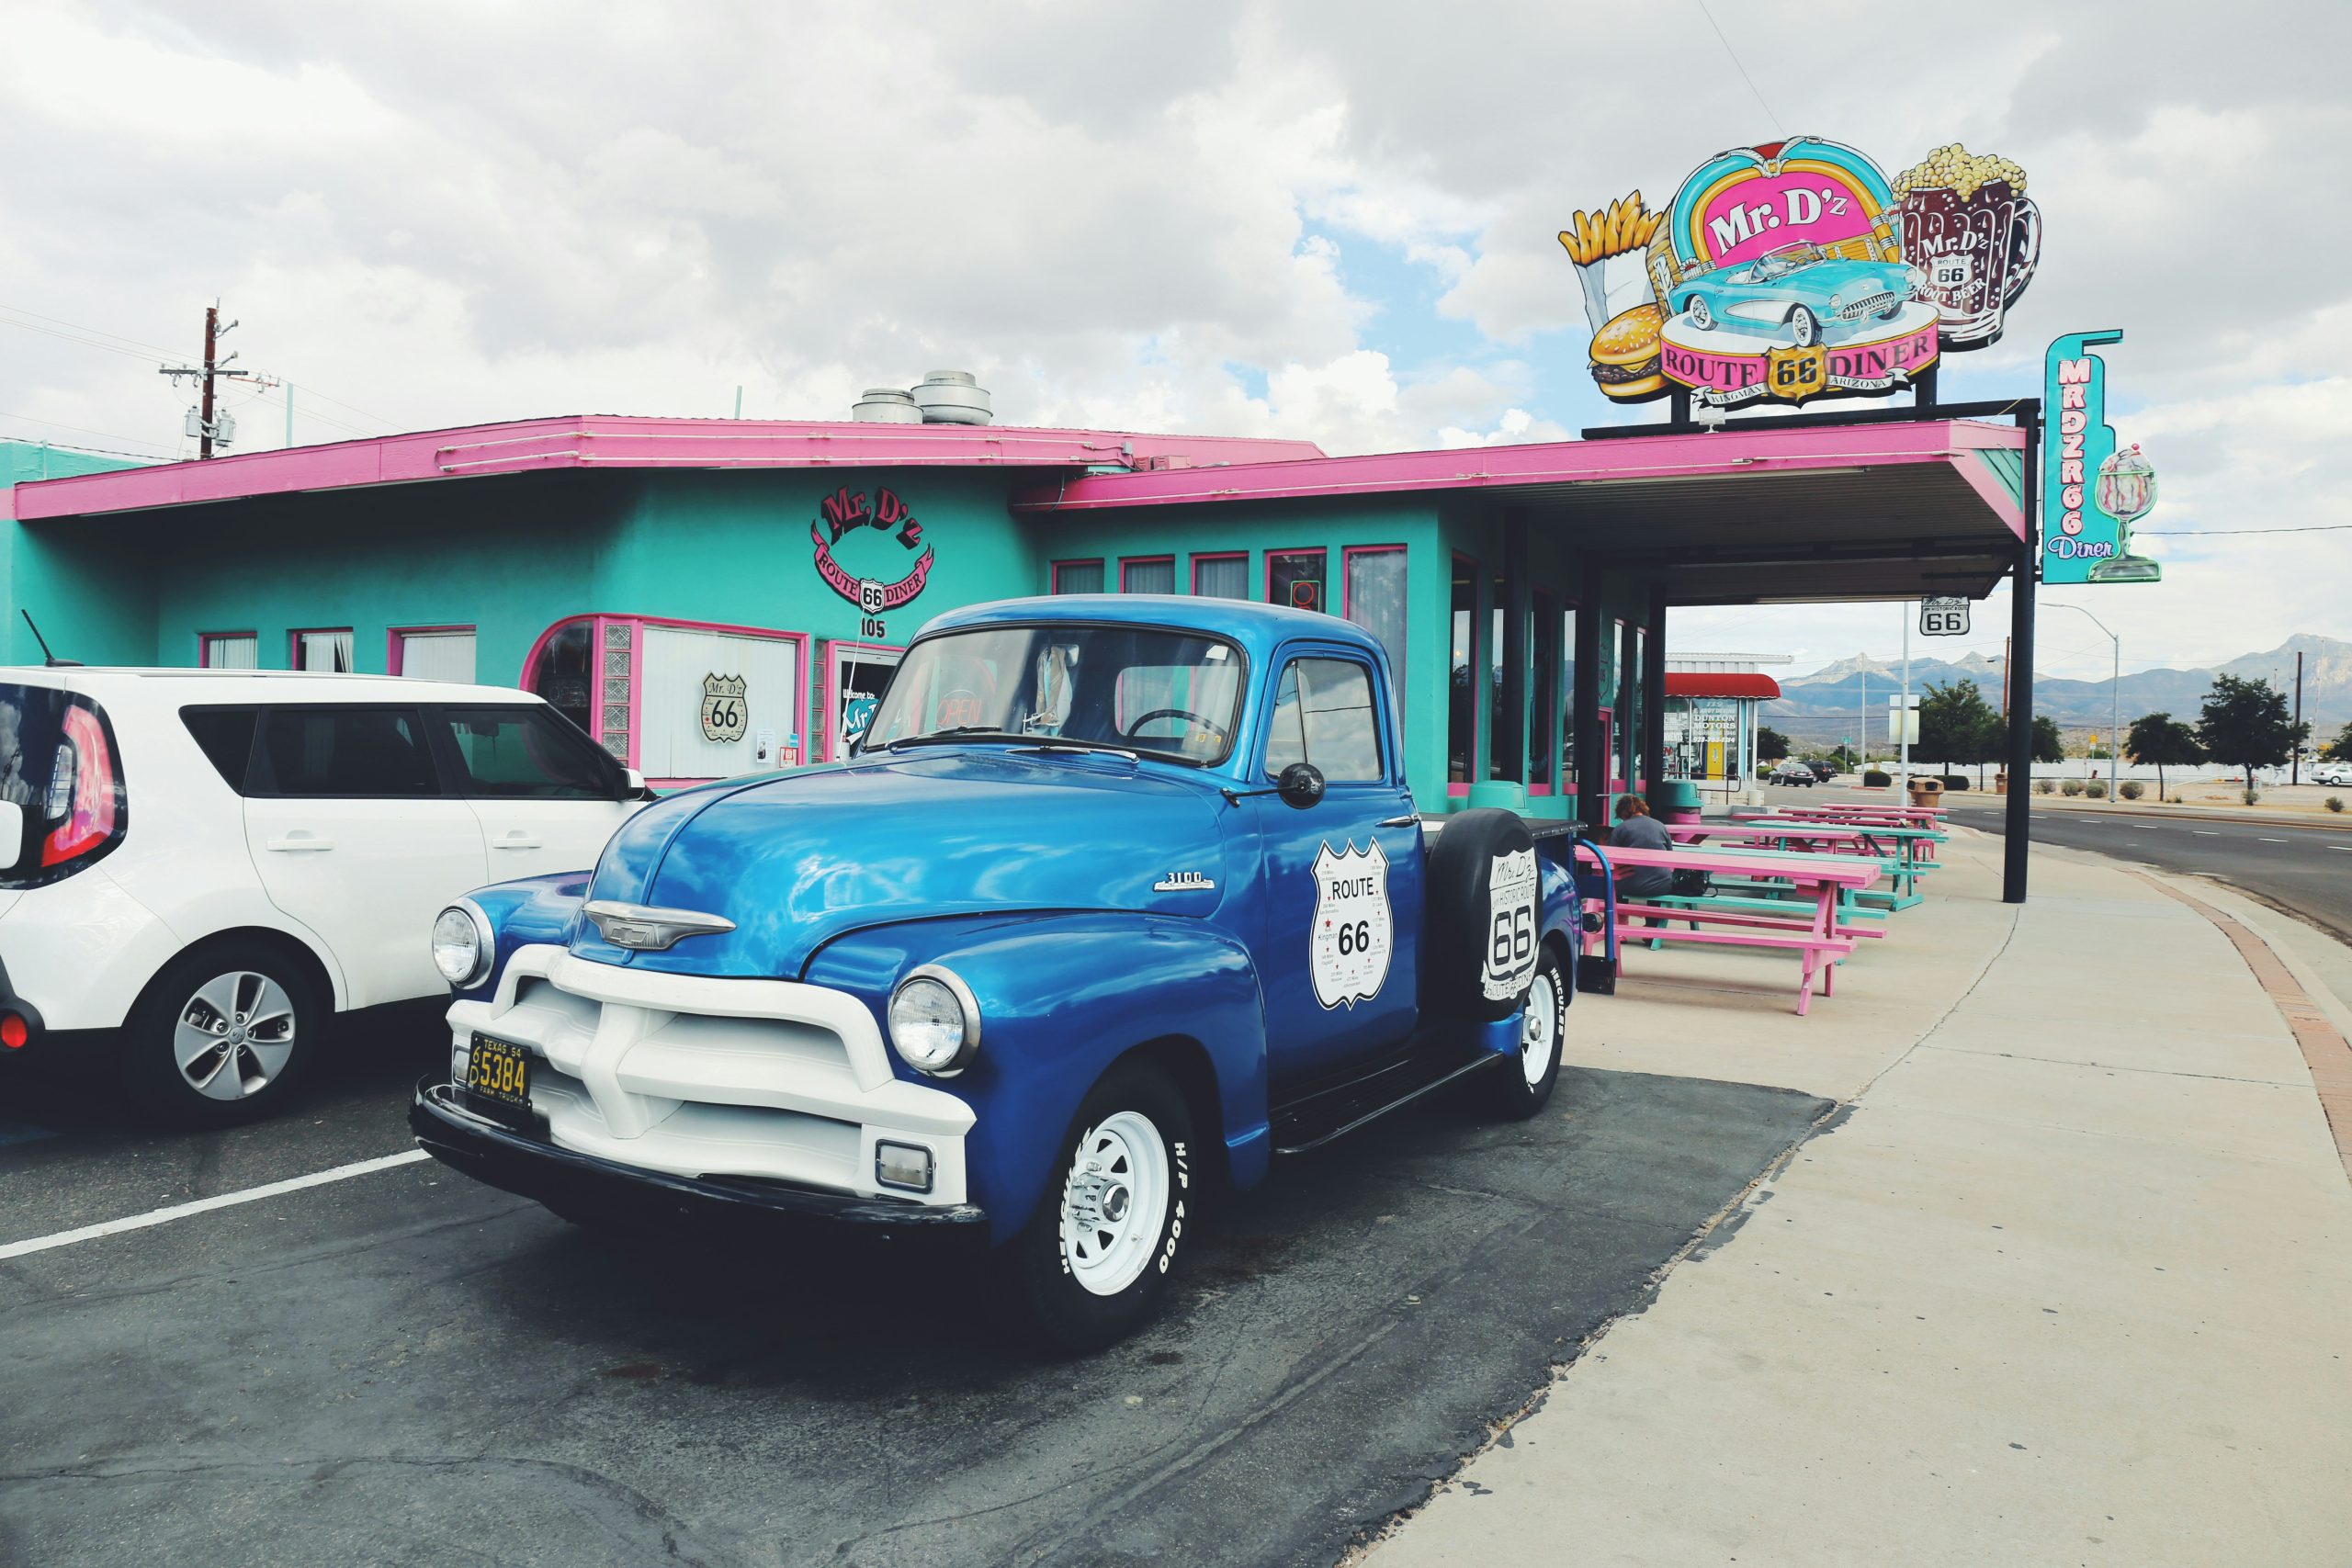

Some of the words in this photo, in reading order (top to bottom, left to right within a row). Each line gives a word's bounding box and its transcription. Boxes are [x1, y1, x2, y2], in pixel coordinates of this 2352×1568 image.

[1708, 201, 1781, 258] Mr.
[1780, 187, 1849, 226] D'z
[1920, 233, 1959, 258] Mr.
[1960, 231, 1989, 250] D'z
[1938, 268, 1964, 282] 66
[1918, 283, 1950, 302] ROOT
[1952, 277, 1986, 302] BEER
[1665, 347, 1758, 387] ROUTE
[1776, 357, 1816, 386] 66
[1828, 334, 1930, 378] DINER
[1711, 384, 1764, 403] KINGMAN
[1830, 375, 1887, 389] ARIZONA
[820, 485, 871, 546] Mr.
[871, 486, 923, 550] D'z
[2047, 536, 2113, 559] Diner
[818, 552, 859, 596] ROUTE
[863, 587, 882, 606] 66
[886, 573, 922, 602] DINER
[861, 617, 886, 637] 105
[1927, 613, 1961, 630] 66
[708, 682, 725, 694] Mr.
[728, 683, 742, 694] D'z
[712, 700, 738, 728] 66
[937, 698, 982, 725] OPEN
[1168, 872, 1202, 883] 3100
[1332, 877, 1374, 900] ROUTE
[1317, 932, 1339, 942] Kingman
[1338, 920, 1369, 955] 66
[1494, 905, 1532, 965] 66
[1549, 967, 1566, 1036] HERCULES
[484, 1039, 507, 1055] TEXAS
[511, 1047, 522, 1058] 54
[481, 1051, 525, 1096] 5384
[480, 1087, 494, 1096] FARM
[1174, 1142, 1188, 1189] H/P
[1159, 1201, 1184, 1274] 4000
